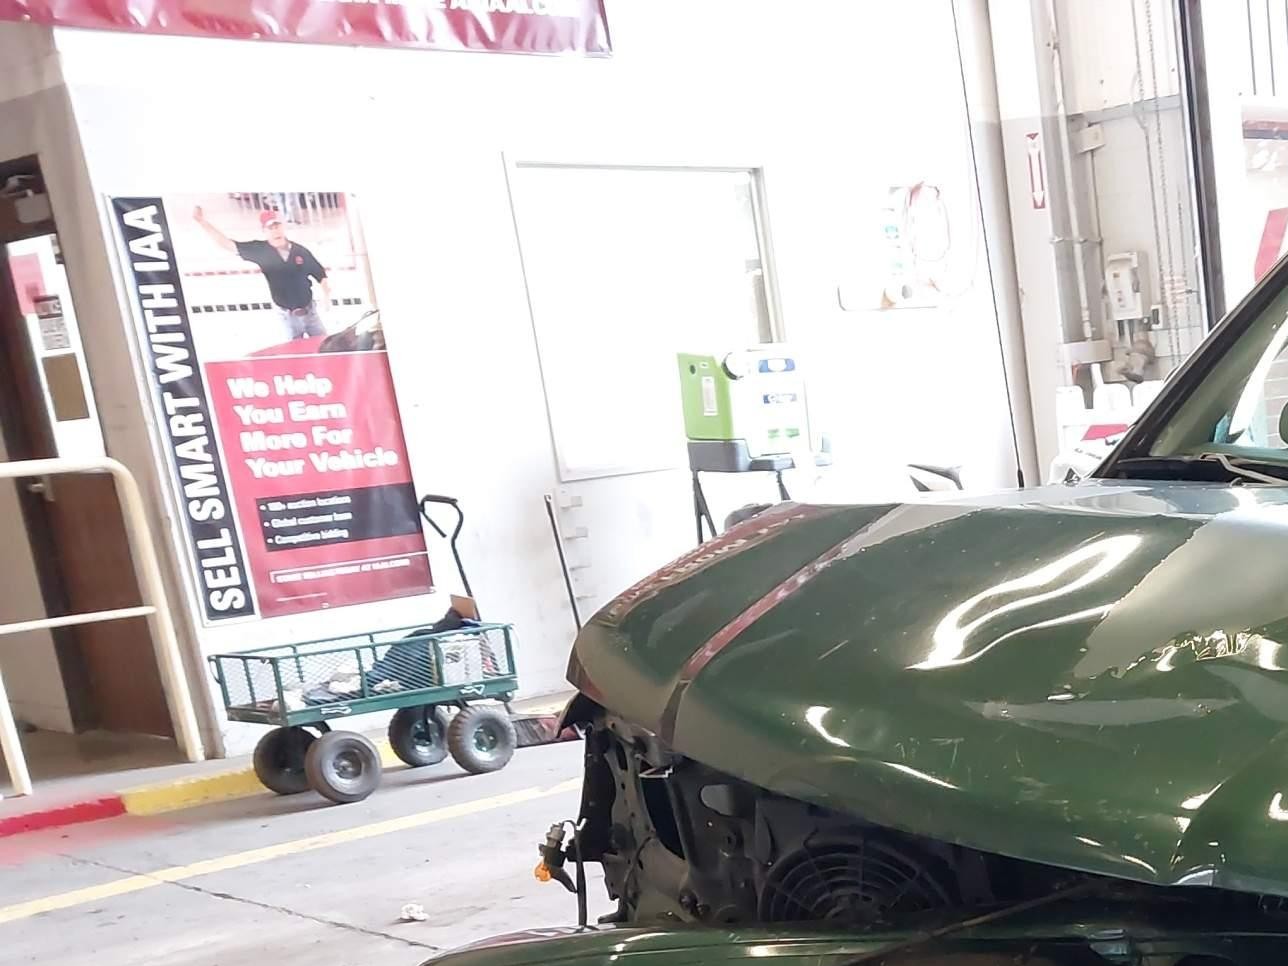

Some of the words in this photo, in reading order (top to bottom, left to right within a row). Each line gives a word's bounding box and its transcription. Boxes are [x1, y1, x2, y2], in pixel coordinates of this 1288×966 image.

[122, 205, 170, 272] IAA
[138, 283, 193, 385] WITH
[226, 377, 270, 399] We
[273, 373, 333, 398] Help
[233, 404, 284, 426] You
[287, 400, 348, 422] Earn
[163, 391, 225, 521] SMART
[239, 430, 307, 453] More
[311, 425, 353, 447] For
[245, 457, 305, 479] Your
[308, 446, 399, 473] Vehicle
[197, 528, 246, 611] SELL
